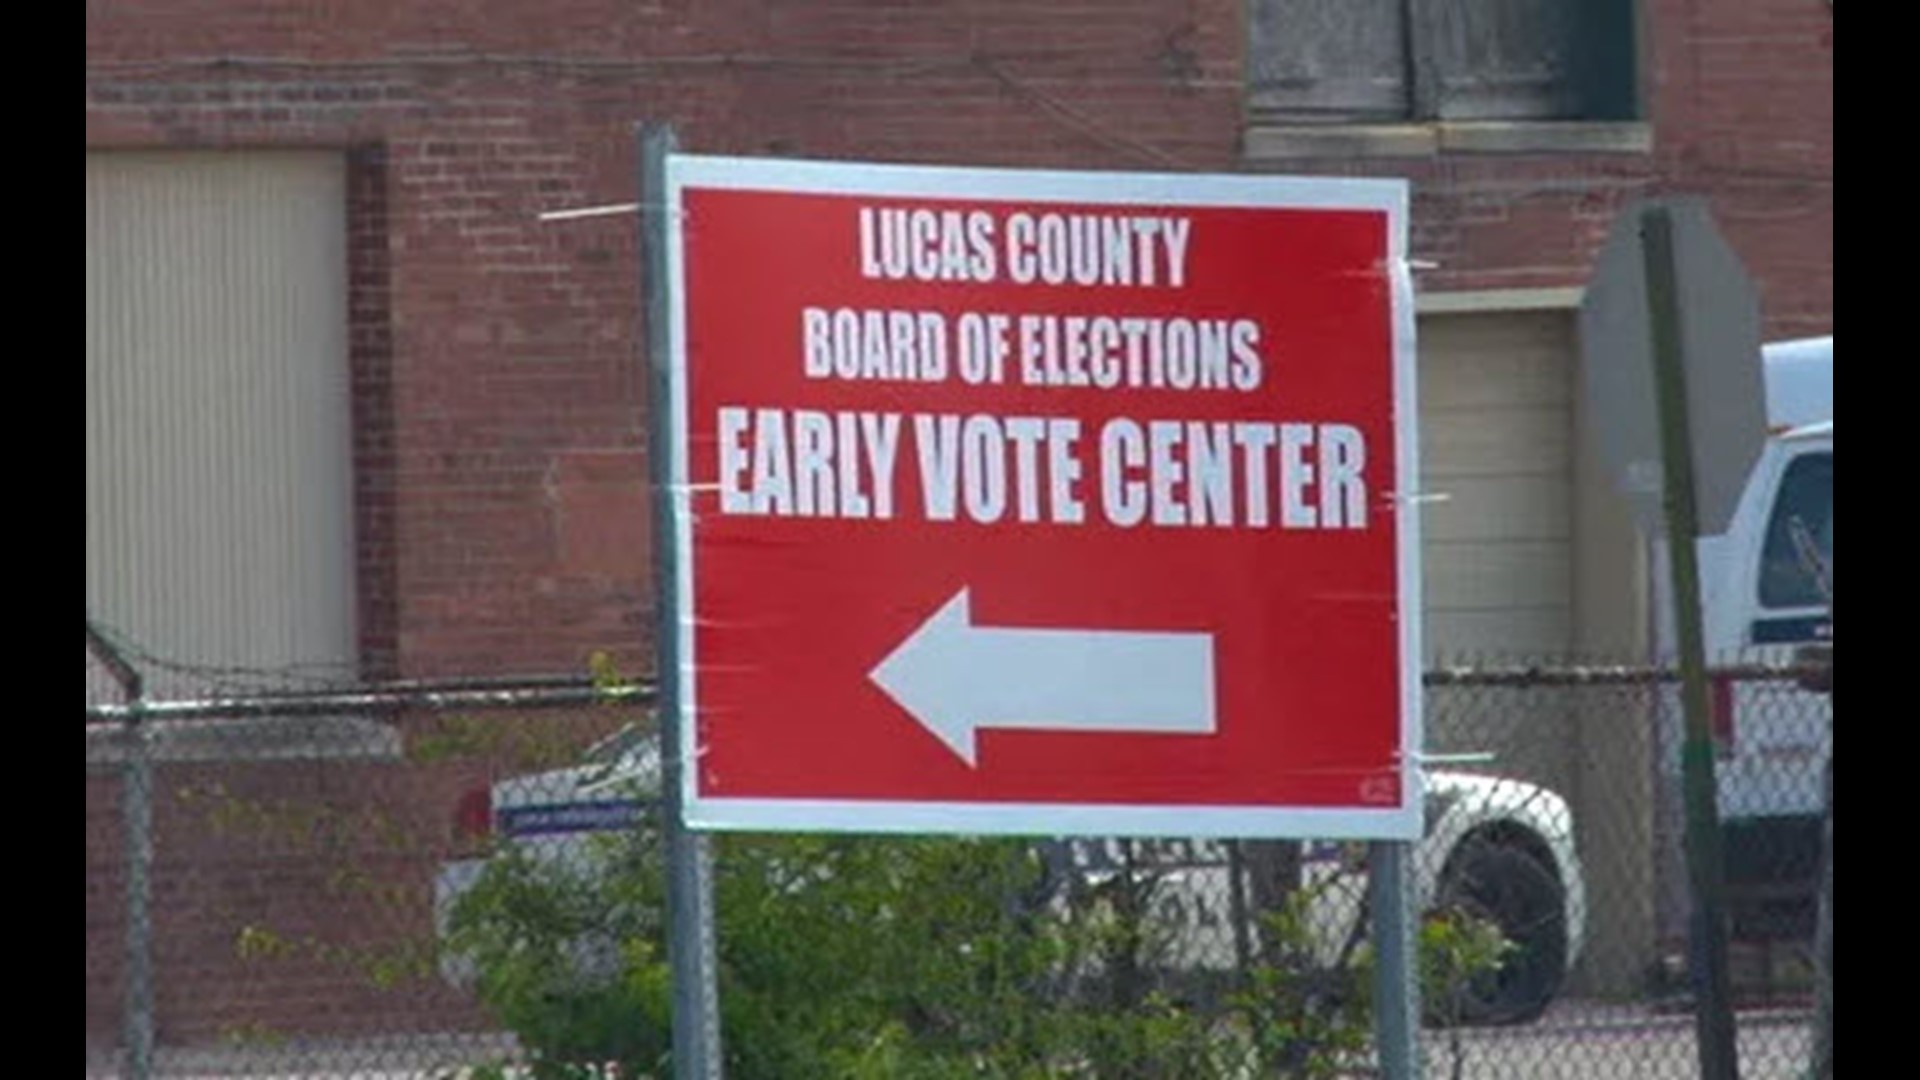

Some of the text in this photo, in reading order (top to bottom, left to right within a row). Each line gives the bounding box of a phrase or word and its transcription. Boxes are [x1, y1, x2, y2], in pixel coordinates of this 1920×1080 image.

[859, 207, 1190, 287] LUCAS COUNTY
[802, 307, 1261, 391] BOARD OF ELECTIONS
[718, 407, 1367, 529] EARLY VOTE CENTER
